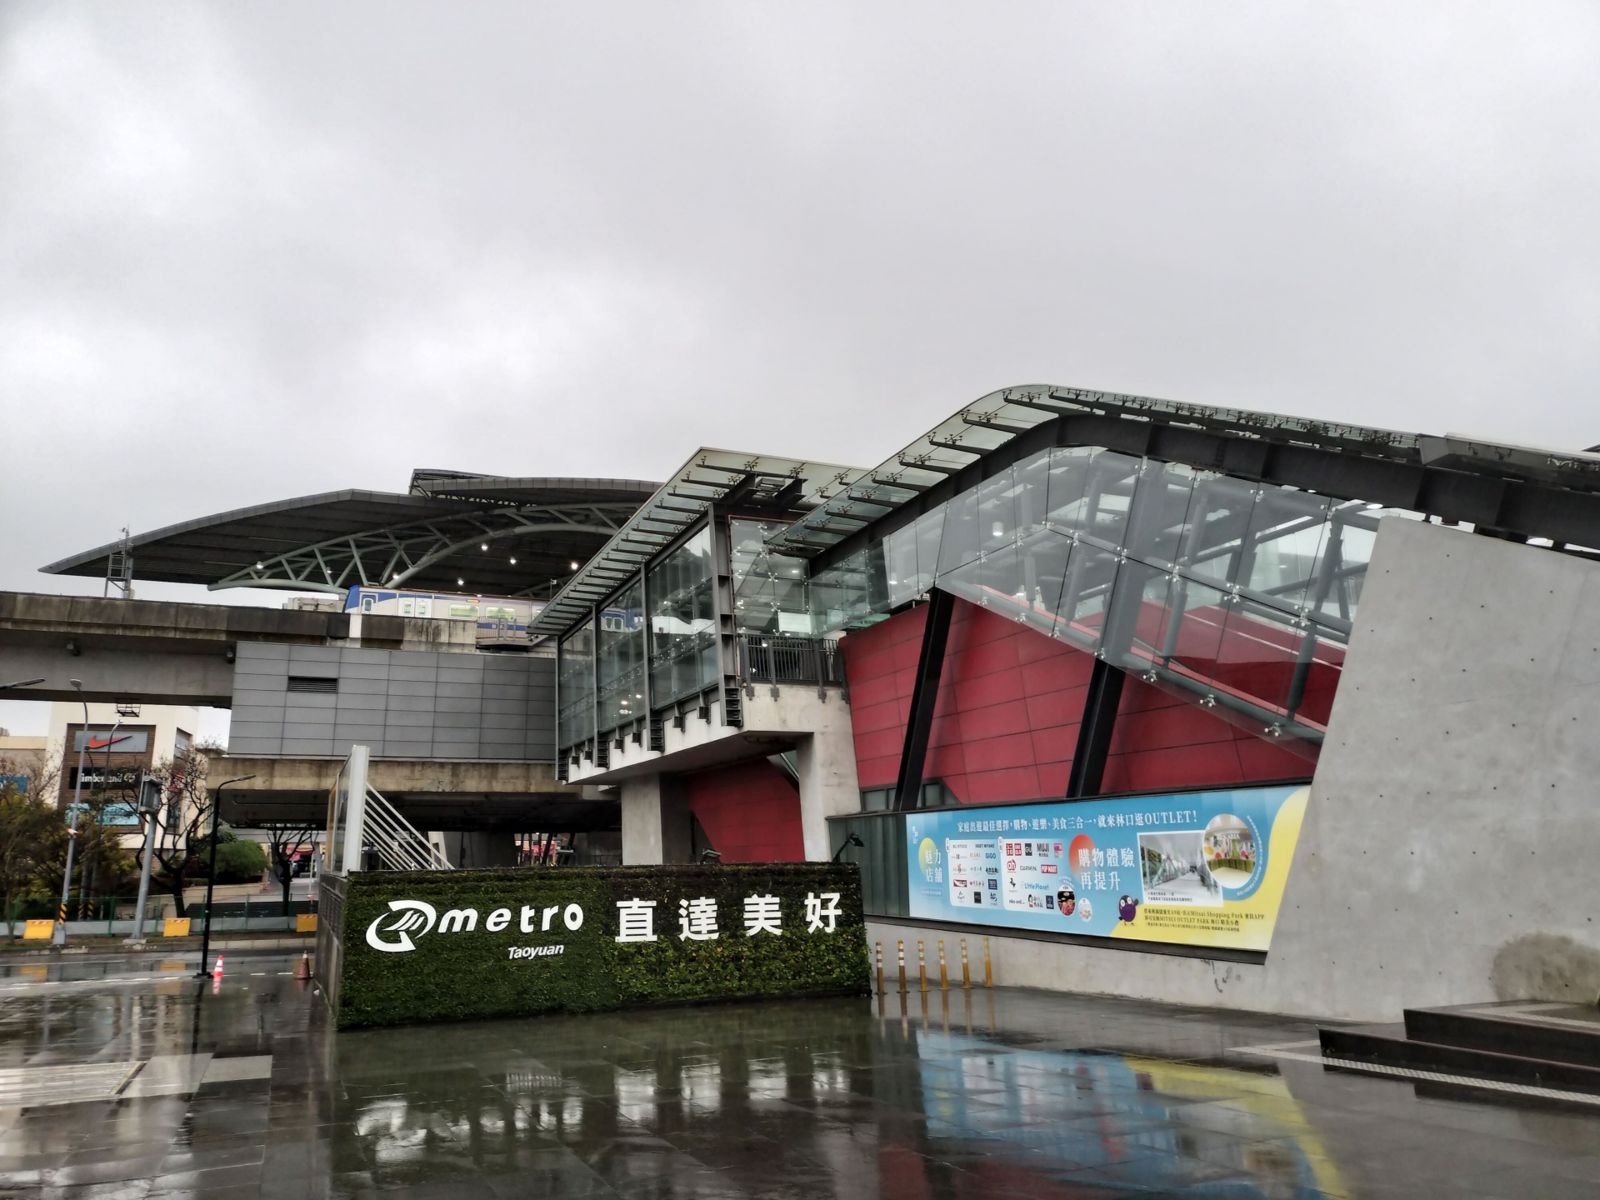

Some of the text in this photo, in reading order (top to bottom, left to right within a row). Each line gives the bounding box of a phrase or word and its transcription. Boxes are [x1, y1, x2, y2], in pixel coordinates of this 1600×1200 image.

[79, 772, 123, 783] imberand
[1037, 843, 1049, 852] MUJI
[1077, 848, 1135, 868] 購物體驗
[1080, 871, 1121, 891] 再提升
[437, 902, 584, 934] metro
[615, 891, 843, 943] 直達美好
[508, 943, 565, 961] Taoyuan
